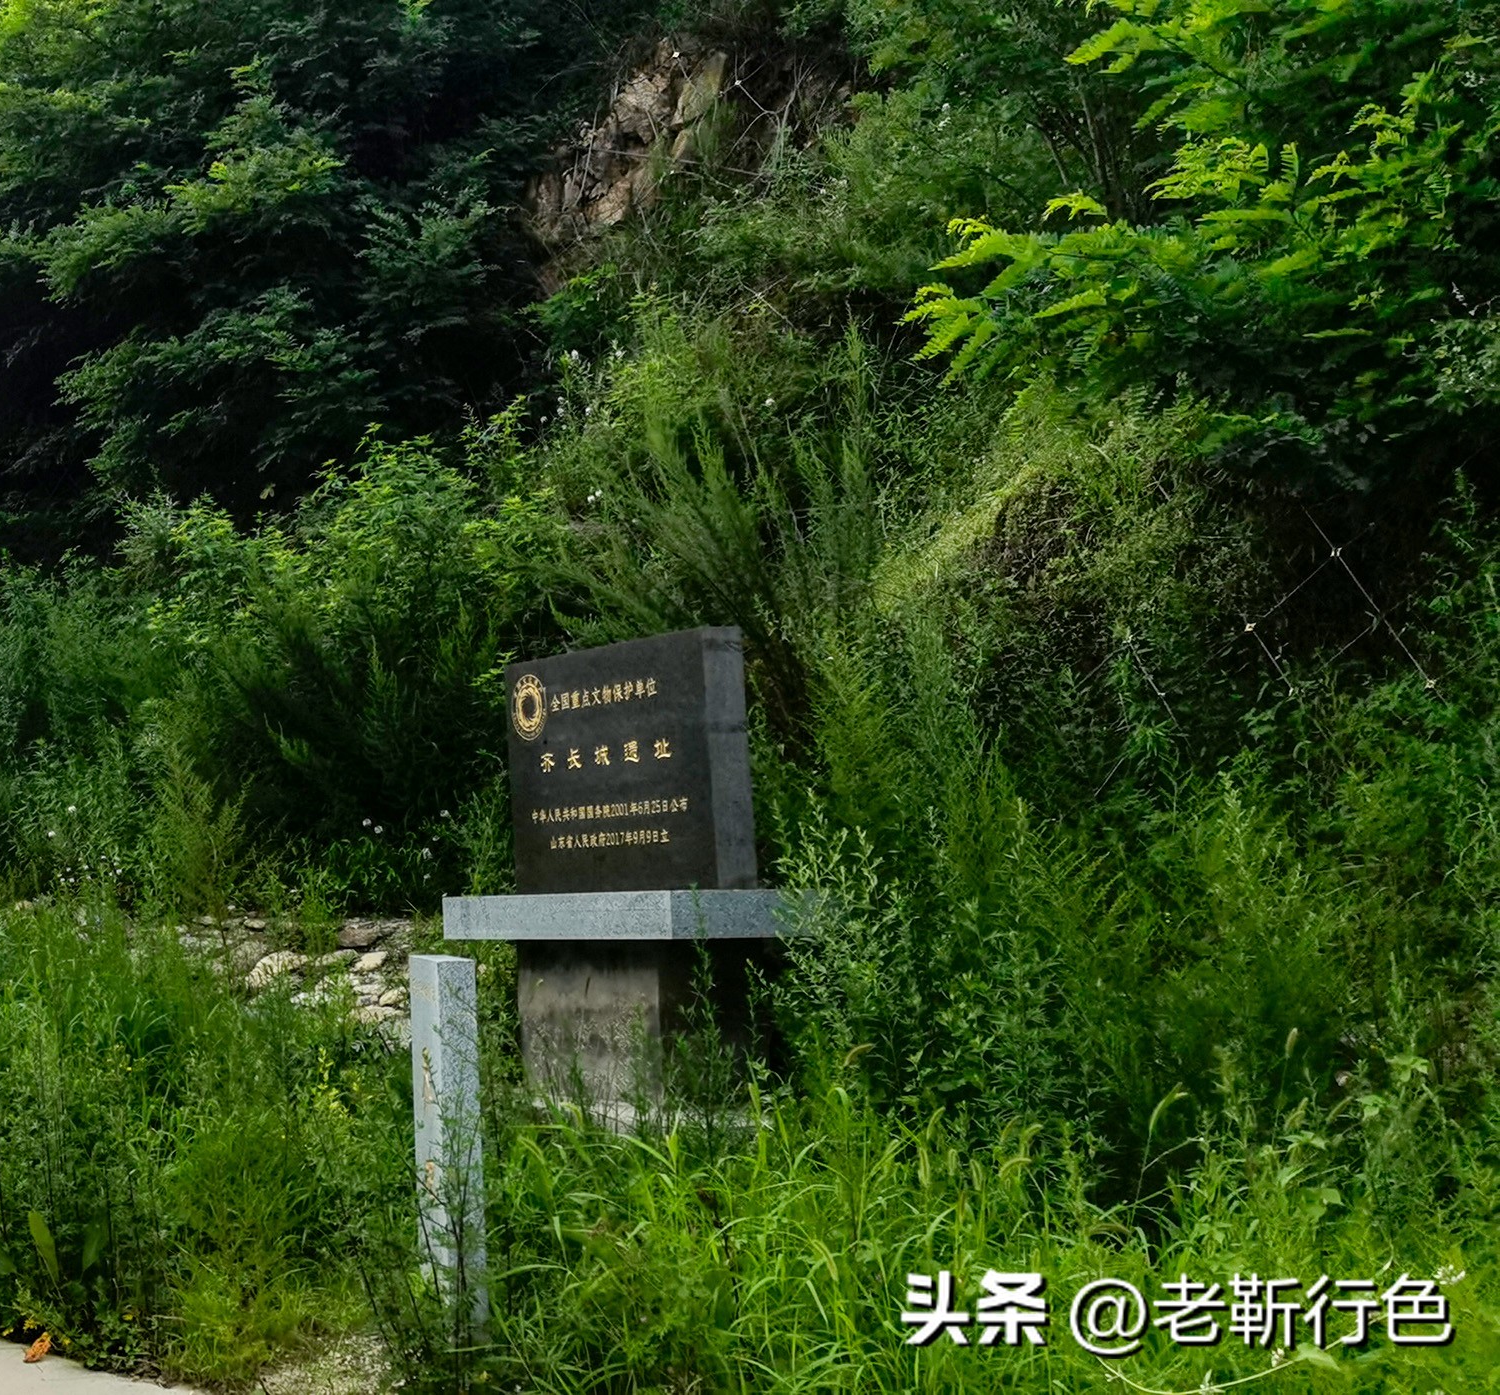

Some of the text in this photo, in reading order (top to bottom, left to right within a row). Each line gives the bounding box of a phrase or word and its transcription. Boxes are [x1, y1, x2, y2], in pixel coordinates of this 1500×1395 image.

[550, 677, 658, 713] 全国重点文物保护单位
[540, 738, 673, 773] 齐长城遗址
